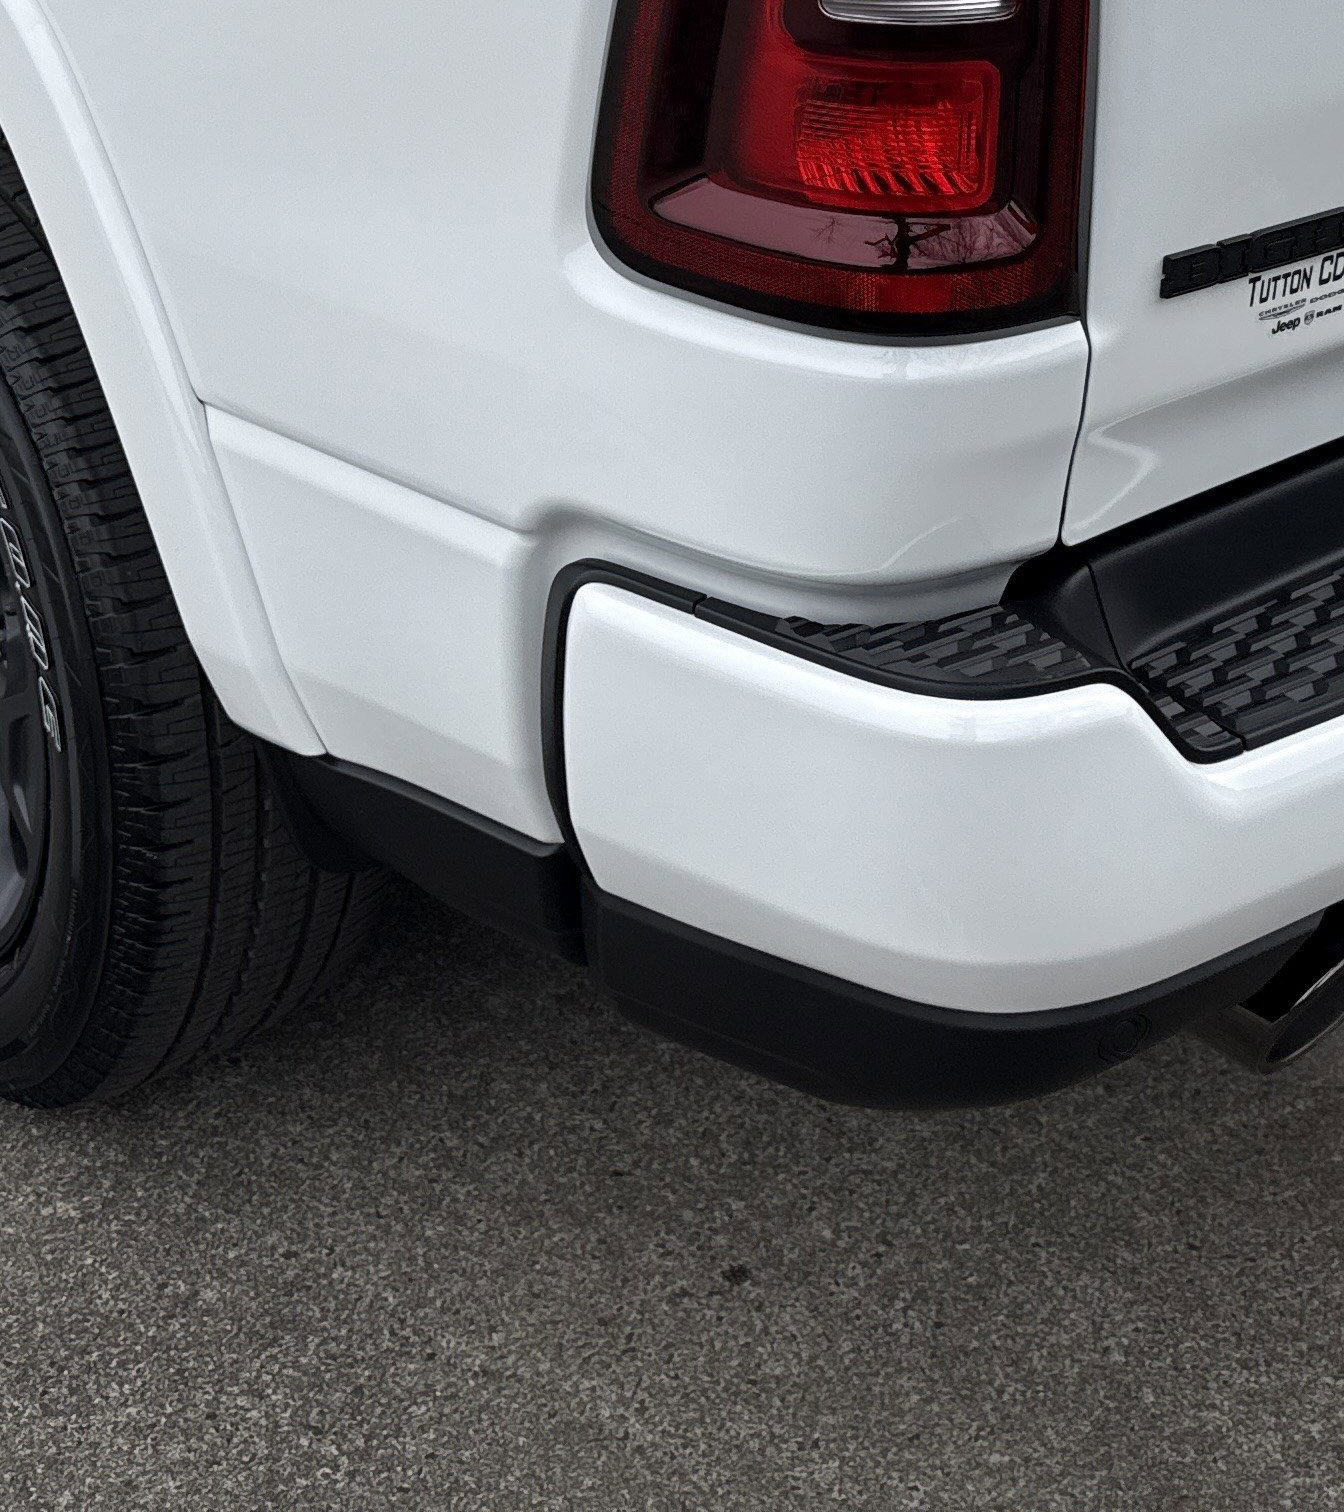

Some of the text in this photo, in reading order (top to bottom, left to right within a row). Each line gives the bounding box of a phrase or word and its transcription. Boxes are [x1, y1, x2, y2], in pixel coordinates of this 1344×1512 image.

[1248, 265, 1313, 307] TUTTON
[1271, 304, 1343, 335] Jeep RAM
